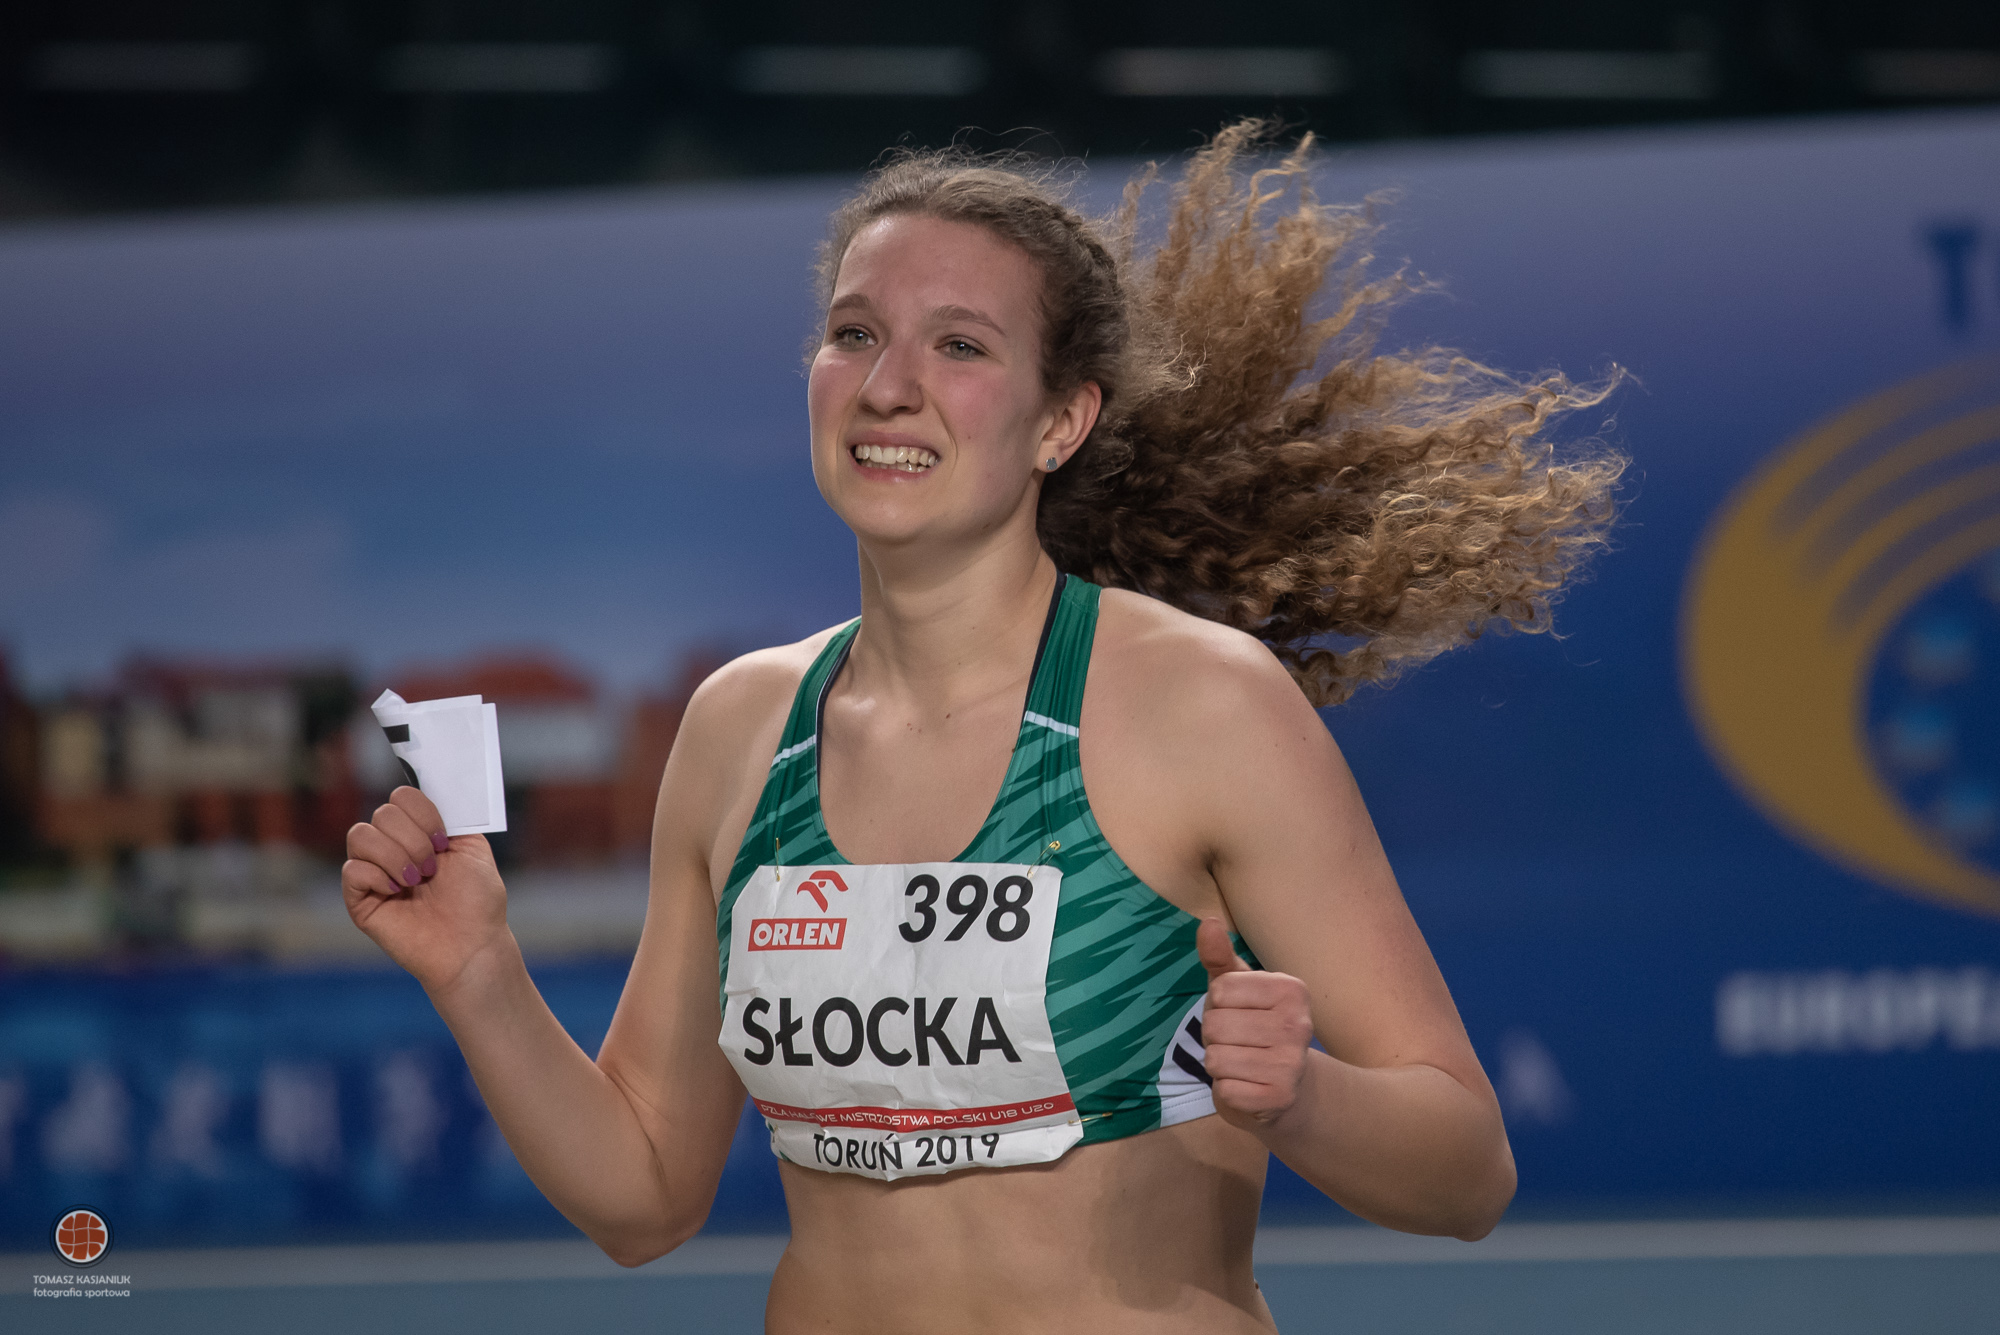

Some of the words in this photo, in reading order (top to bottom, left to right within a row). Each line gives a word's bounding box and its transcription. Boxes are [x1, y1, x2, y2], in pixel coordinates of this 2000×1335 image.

[898, 874, 1034, 943] 398
[752, 922, 841, 947] ORLEN
[742, 996, 1023, 1067] SŁOCKA
[760, 1103, 787, 1118] PZLA
[839, 1111, 930, 1126] MISTRZOSTWA
[933, 1112, 987, 1125] POLSKI
[989, 1109, 1018, 1121] U18
[1021, 1102, 1054, 1115] U20
[812, 1132, 904, 1172] TORUŃ
[914, 1132, 1000, 1168] 2019
